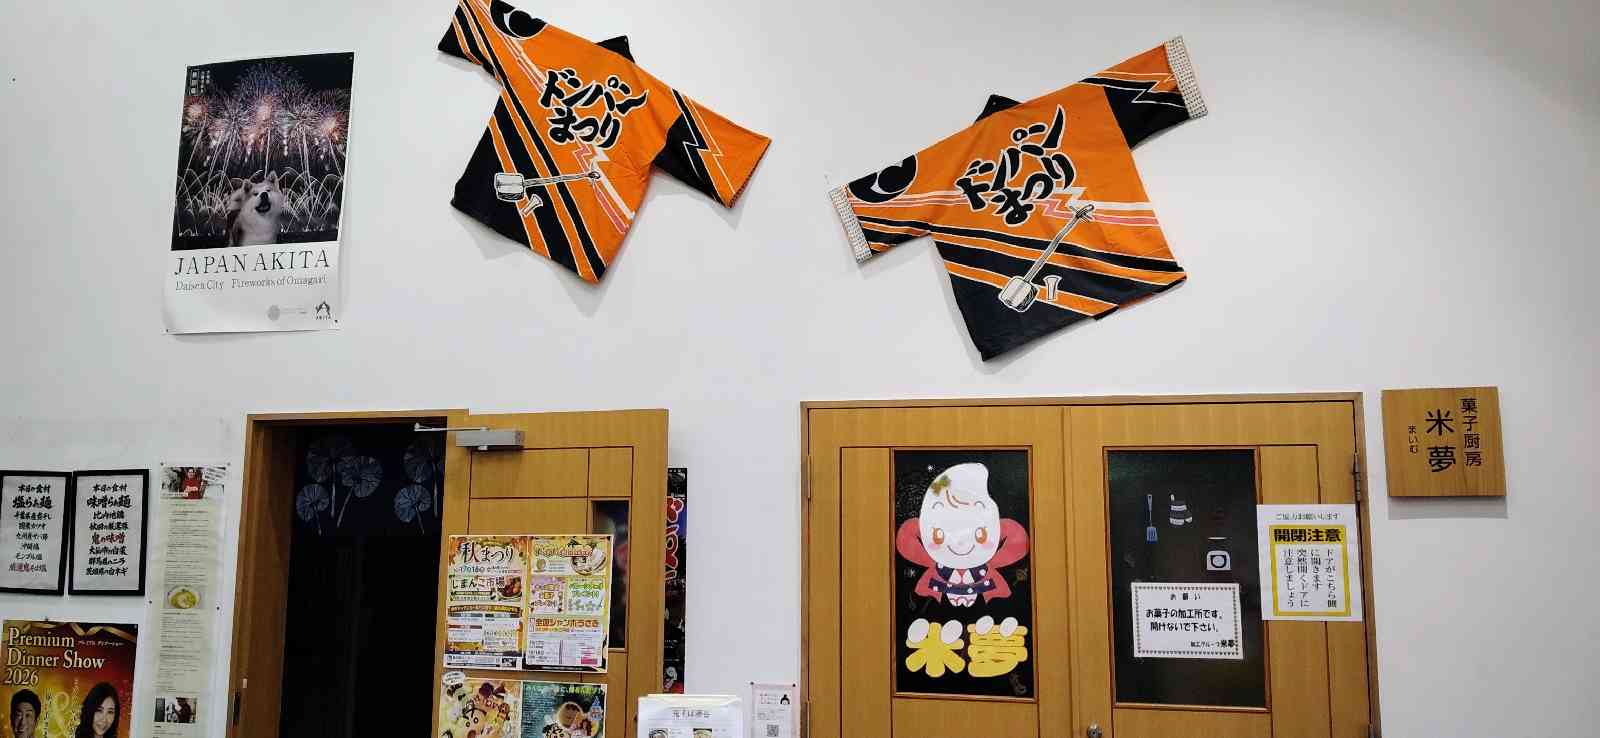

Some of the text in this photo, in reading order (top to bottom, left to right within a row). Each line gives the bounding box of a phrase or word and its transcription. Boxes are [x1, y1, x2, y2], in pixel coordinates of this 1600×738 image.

[538, 67, 650, 116] ドンパン
[546, 107, 622, 150] まつり
[954, 104, 1066, 212] ドンパン
[991, 152, 1077, 227] まつり
[174, 249, 330, 276] JAPAN AKITA
[206, 279, 224, 291] City
[231, 276, 276, 289] Fireworks
[276, 276, 286, 286] of
[286, 273, 327, 287] Omagari
[1407, 424, 1420, 455] まいむ
[1425, 408, 1457, 473] 米夢
[1459, 398, 1483, 467] 菓子厨房
[18, 484, 51, 494] 本日の食材
[92, 483, 128, 493] 本日の食材
[1274, 528, 1342, 542] 開閉注意
[459, 541, 514, 563] 秋まつり
[1296, 548, 1313, 609] 突然開くドアに
[1310, 549, 1323, 592] に開きます
[8, 627, 75, 647] Premium
[1150, 621, 1219, 633] 開けないで下さい。
[6, 647, 105, 669] Dinner Show
[905, 614, 1028, 678] 米夢
[4, 668, 40, 686] 2026
